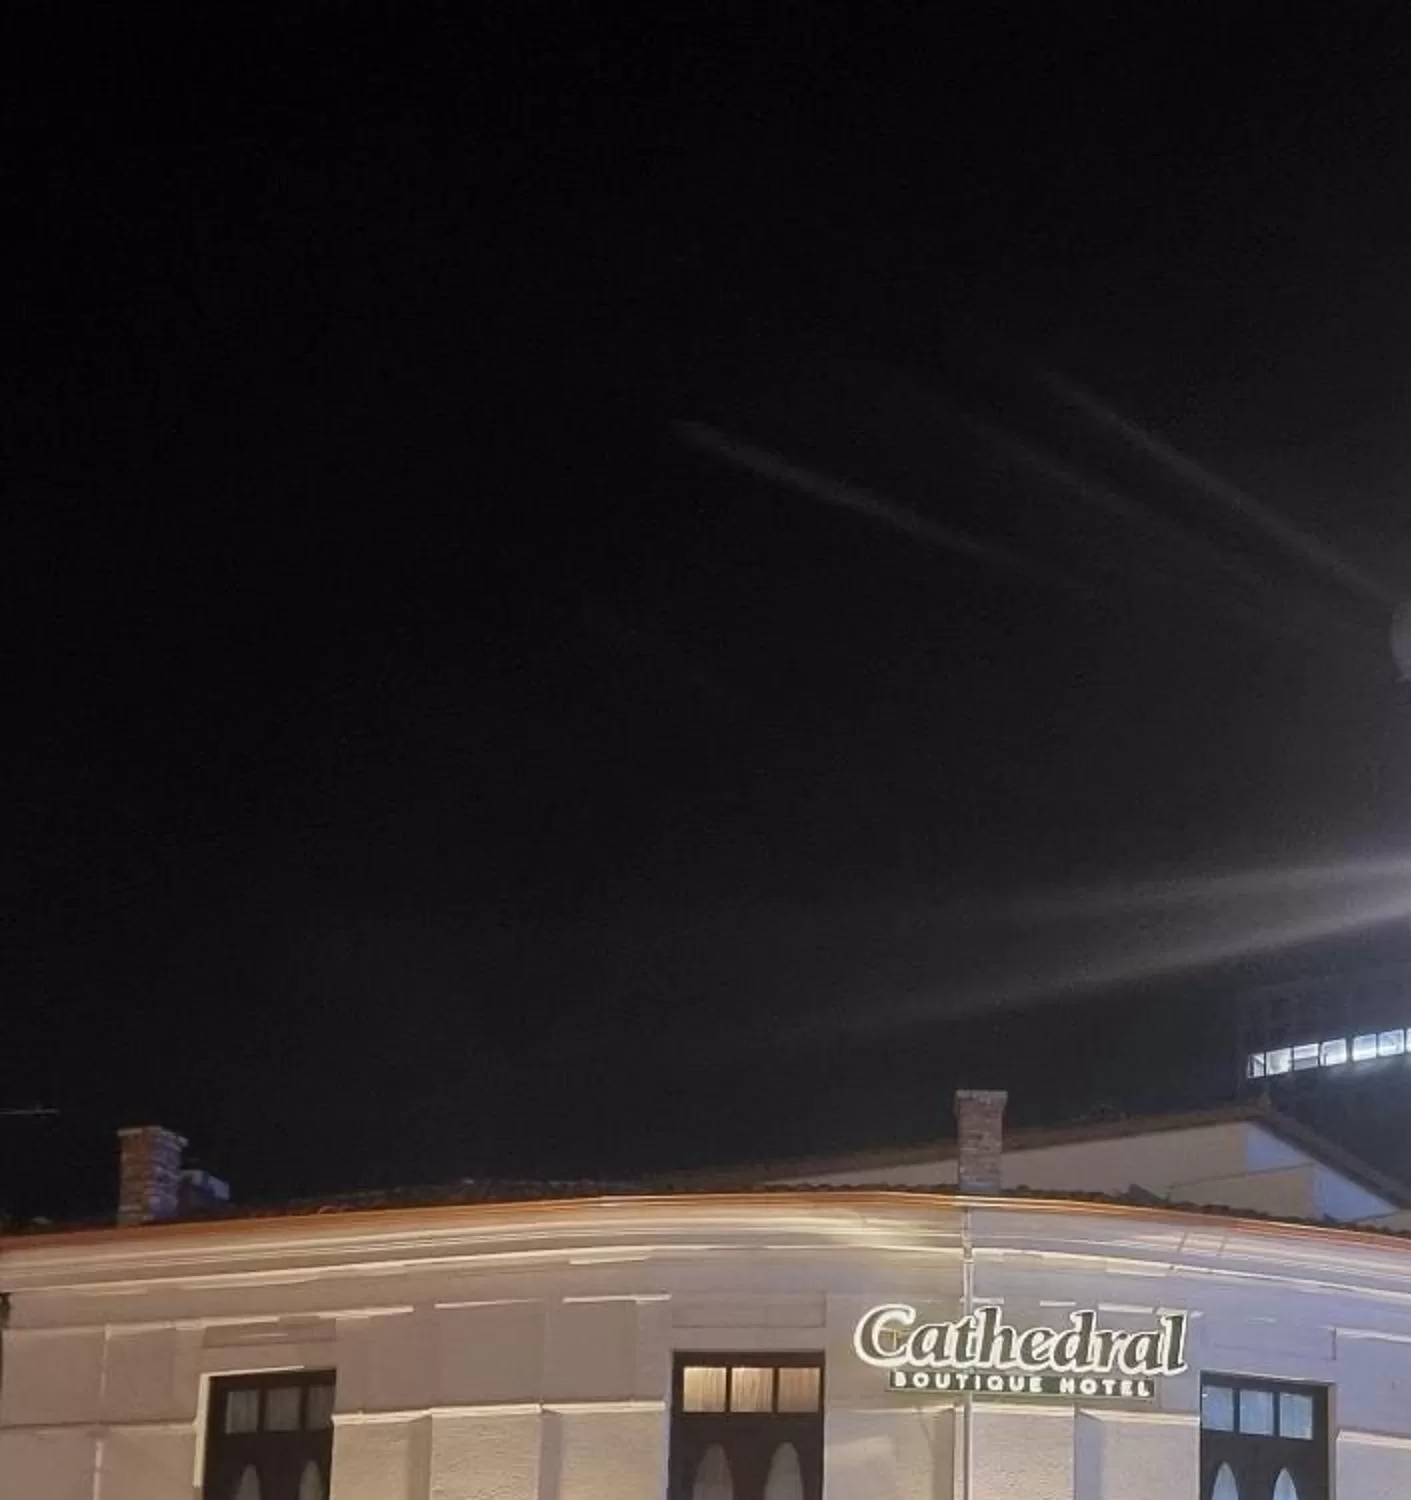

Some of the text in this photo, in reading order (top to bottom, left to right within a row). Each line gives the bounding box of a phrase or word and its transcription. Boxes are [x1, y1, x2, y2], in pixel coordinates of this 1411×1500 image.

[855, 1304, 1188, 1376] Cathedral
[895, 1372, 1151, 1397] BOUTIQUE HOTEL
